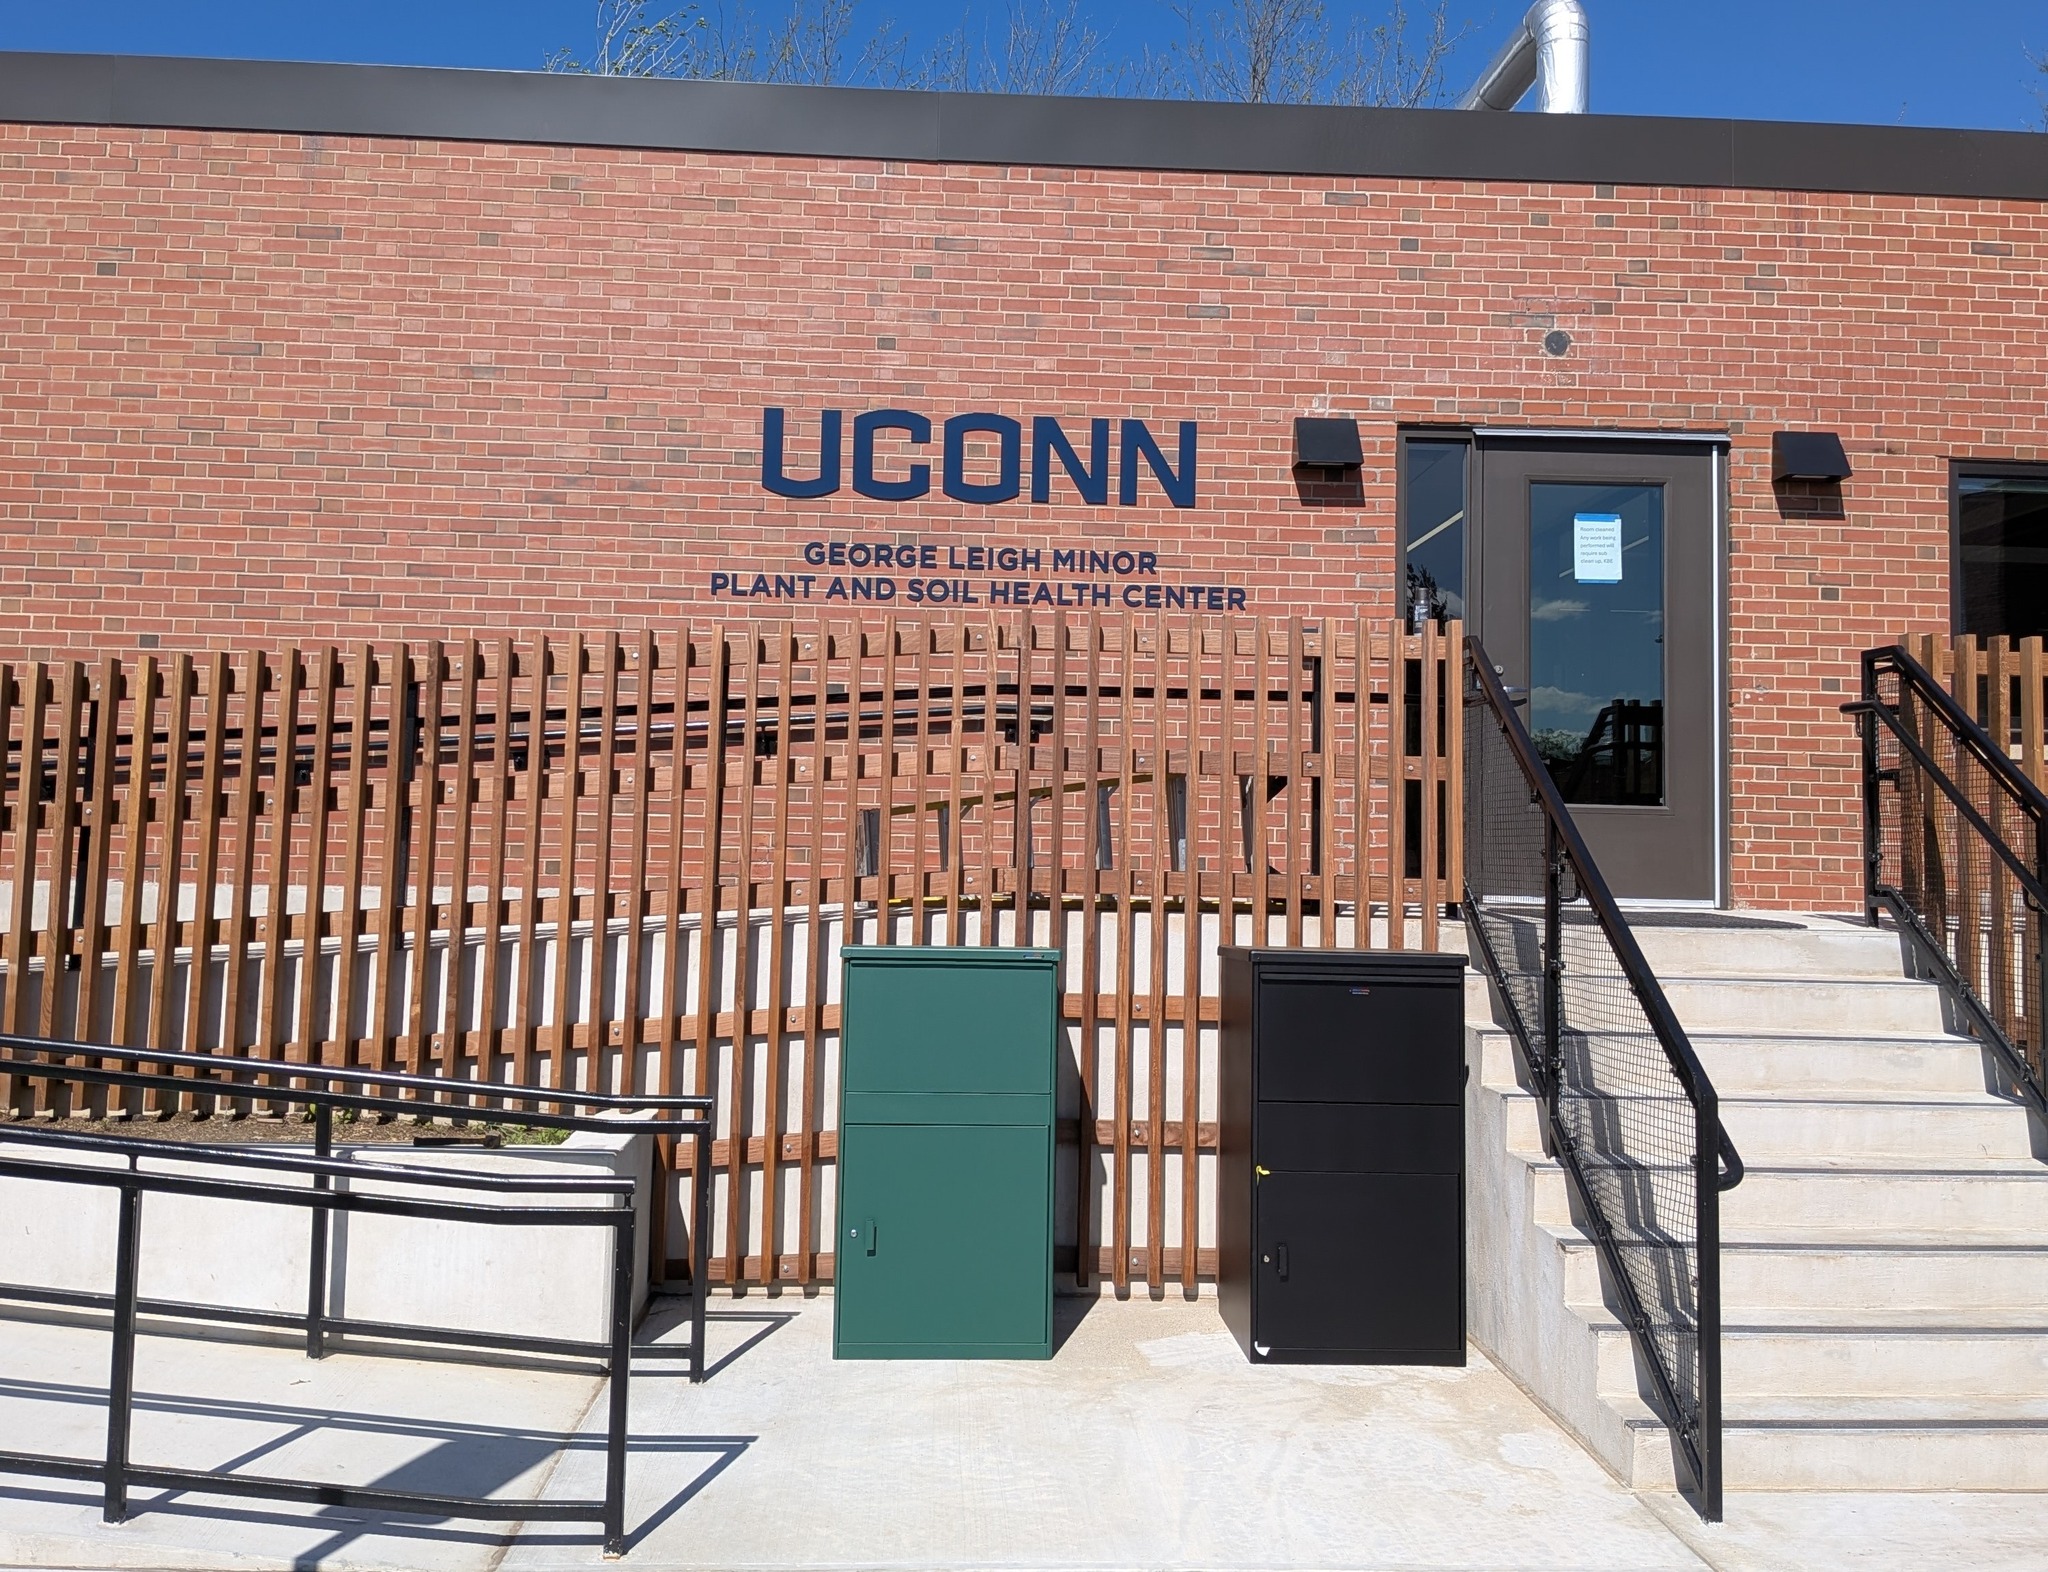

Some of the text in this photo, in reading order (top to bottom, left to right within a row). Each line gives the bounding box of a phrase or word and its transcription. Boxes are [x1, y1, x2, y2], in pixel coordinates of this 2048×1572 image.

[761, 407, 1197, 508] UCONN
[803, 541, 1158, 576] GEORGE LEIGH MINOR
[711, 573, 1247, 612] PLANT AND SOIL HEALTH CENTER
